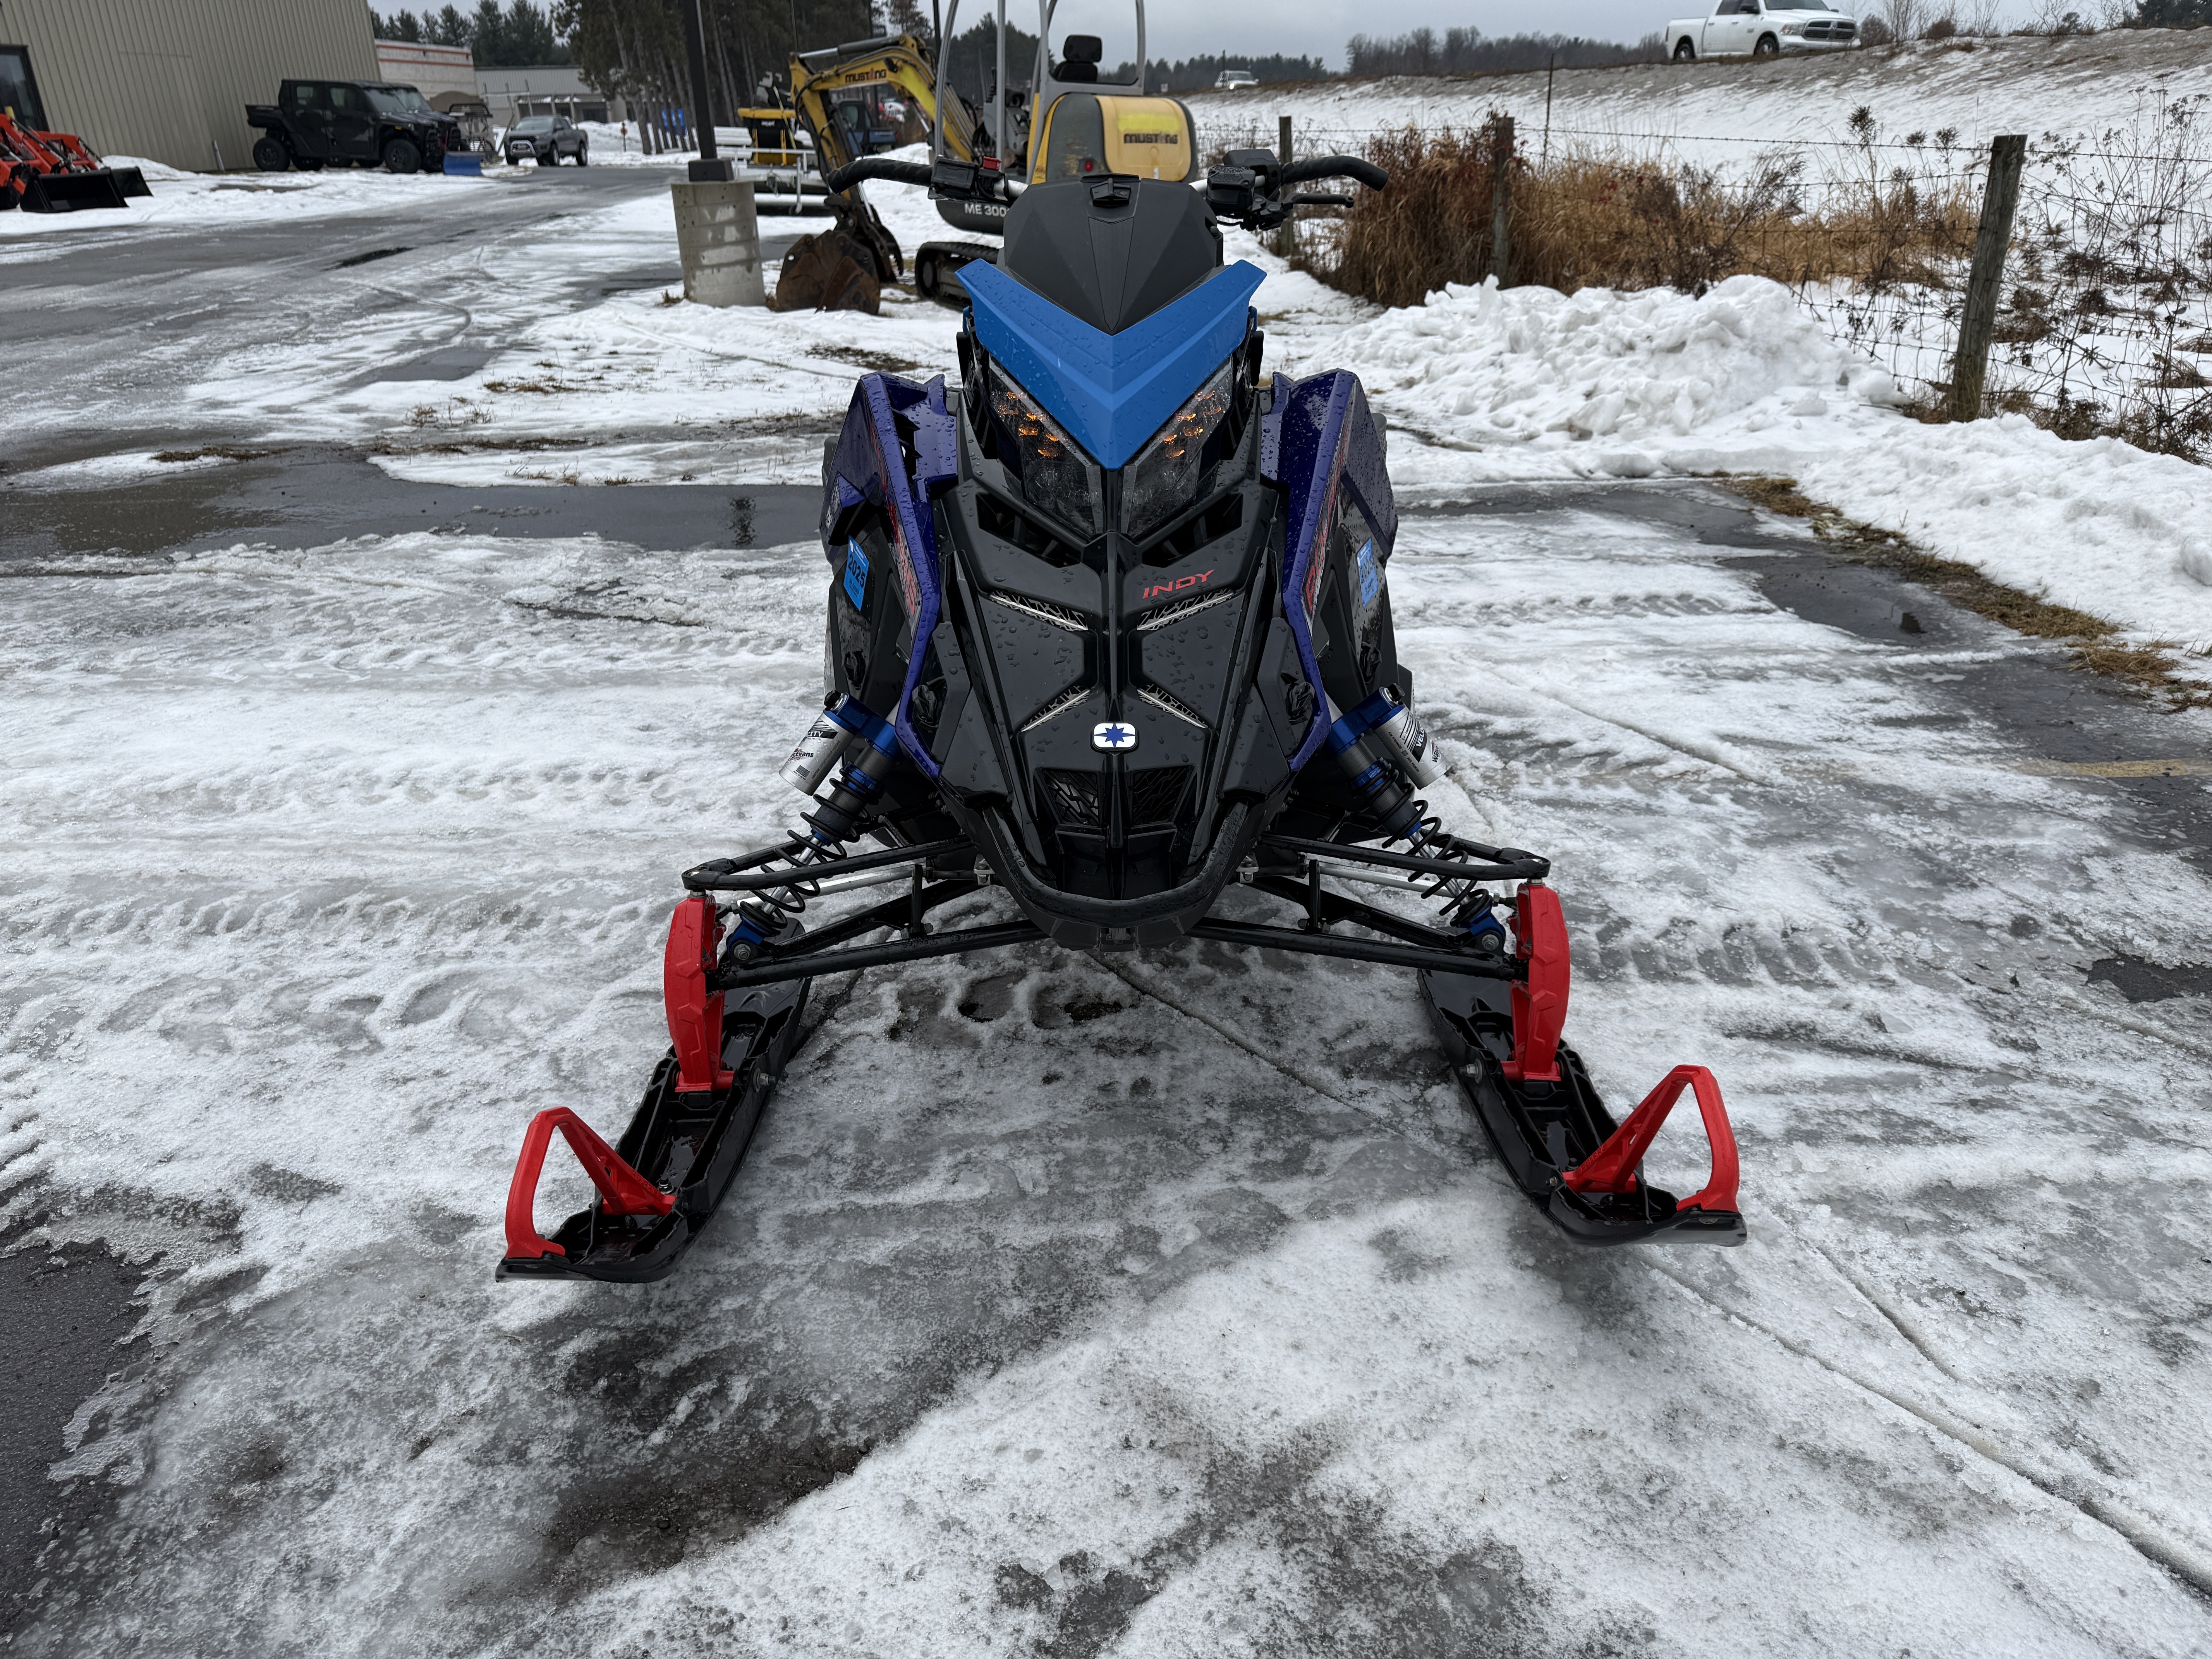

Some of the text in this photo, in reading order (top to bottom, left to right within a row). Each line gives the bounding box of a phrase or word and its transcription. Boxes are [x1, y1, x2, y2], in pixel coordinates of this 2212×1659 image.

[964, 203, 1010, 218] ME 300
[848, 554, 866, 588] 2025
[1143, 569, 1214, 599] INDY
